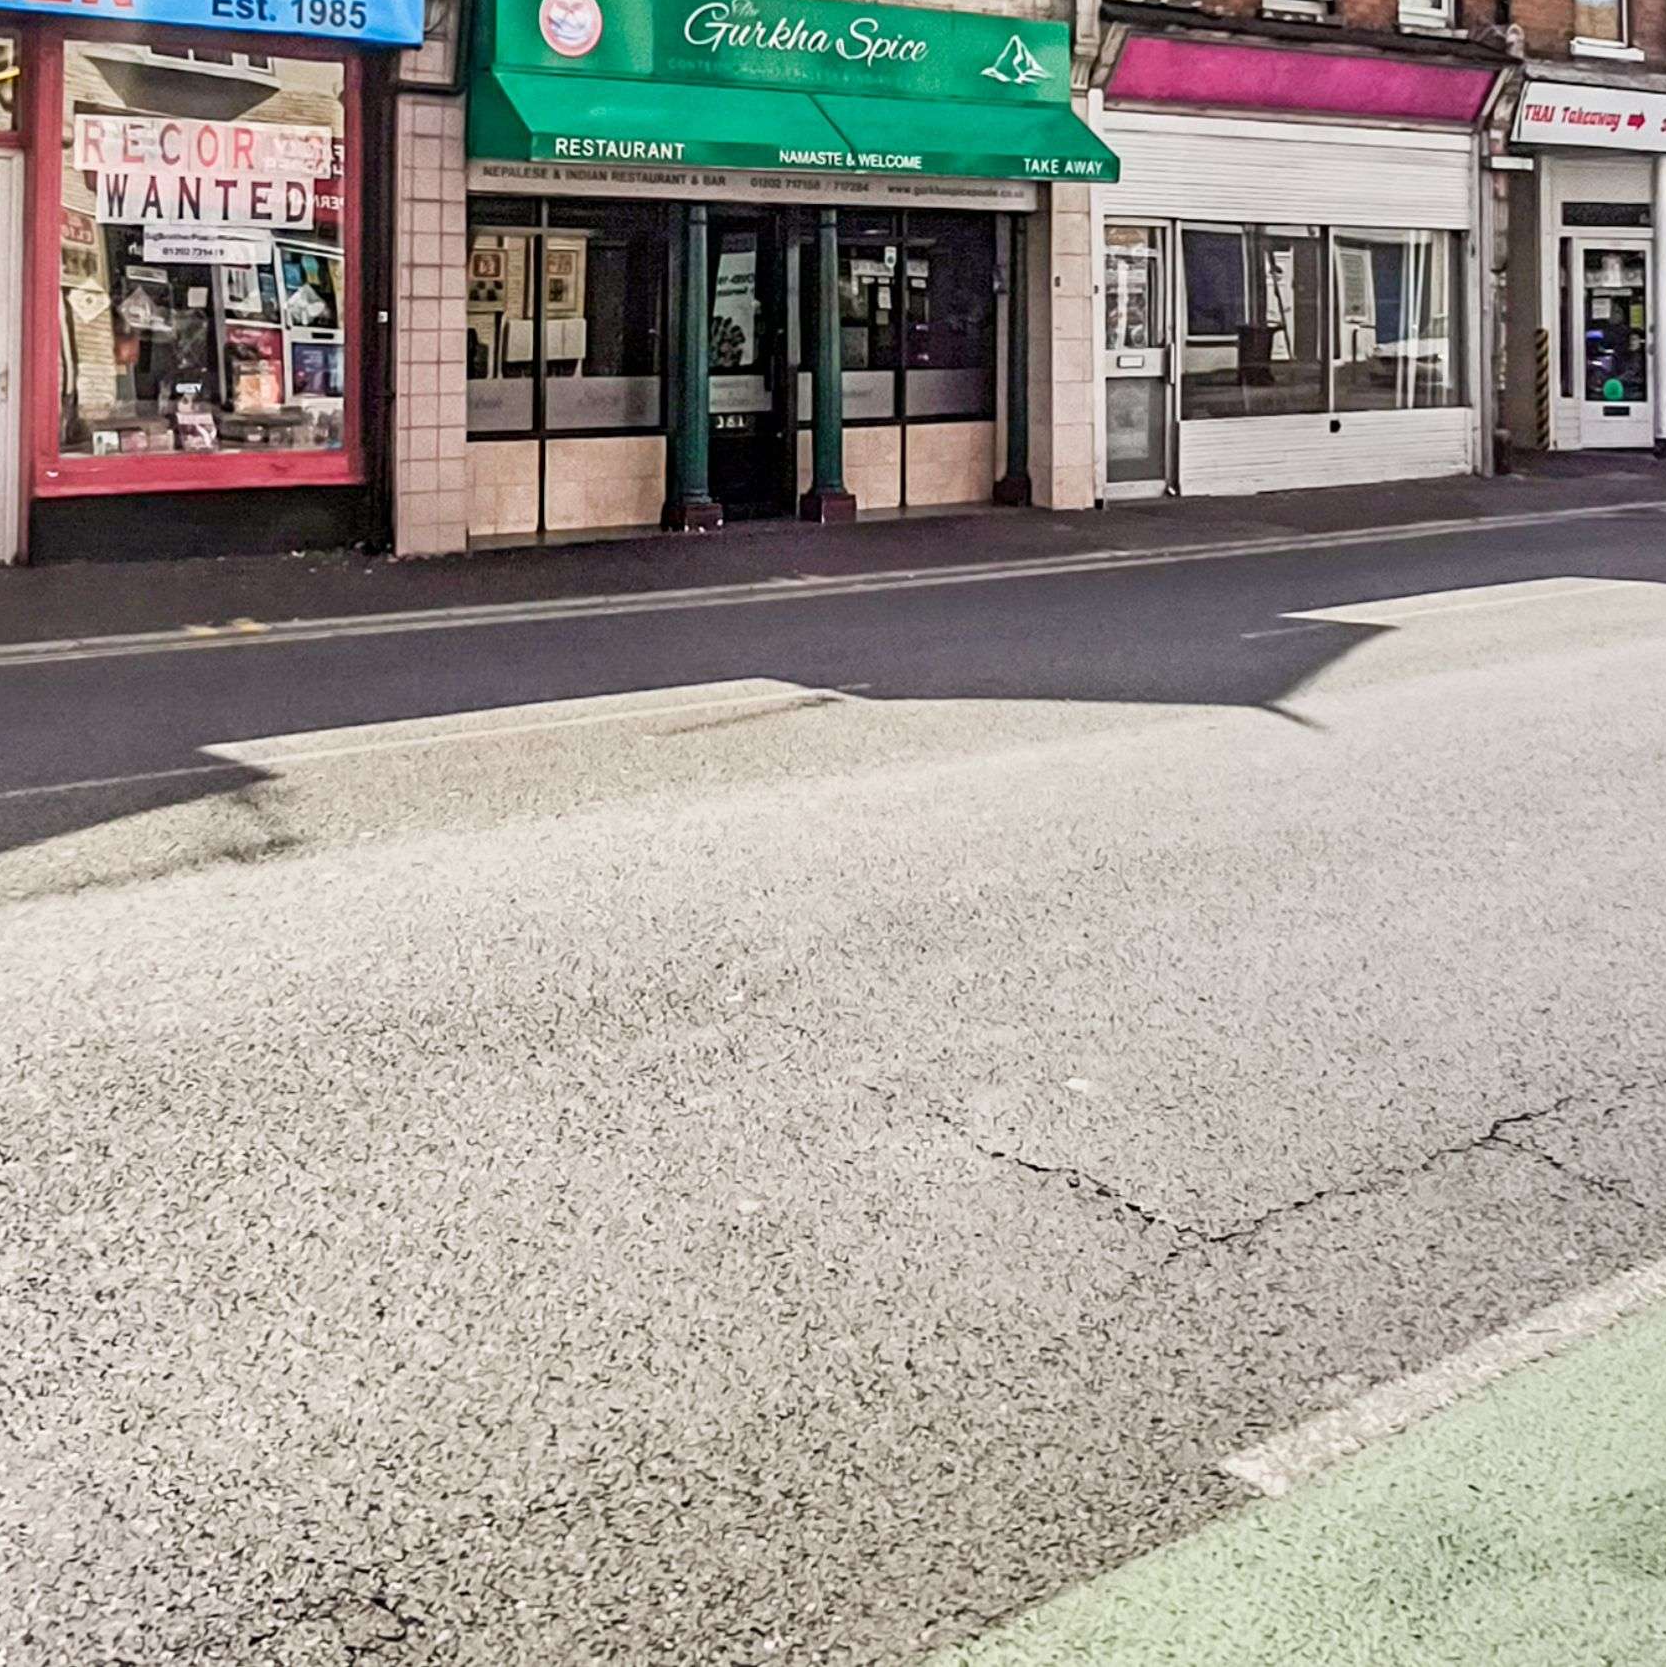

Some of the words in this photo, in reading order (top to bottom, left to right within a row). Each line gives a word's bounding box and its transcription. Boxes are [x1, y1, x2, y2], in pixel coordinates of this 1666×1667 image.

[683, 0, 831, 53] Gurkha
[836, 17, 929, 68] Spice
[1524, 103, 1556, 123] THAI
[1561, 106, 1622, 133] Takeaway
[82, 118, 323, 172] RECOR
[554, 137, 686, 160] RESTAURANT
[779, 150, 843, 167] NAMASTE
[846, 153, 856, 167] &
[858, 153, 923, 170] WELCOME
[1023, 157, 1059, 175] TAKE
[1064, 159, 1104, 176] AWAY
[482, 165, 548, 180] NEPALESE
[552, 168, 561, 180] &
[565, 169, 608, 183] INDIAN
[611, 170, 687, 185] RESTAURANT
[690, 173, 699, 185] &
[702, 174, 726, 186] BAR
[105, 173, 308, 223] WANTED
